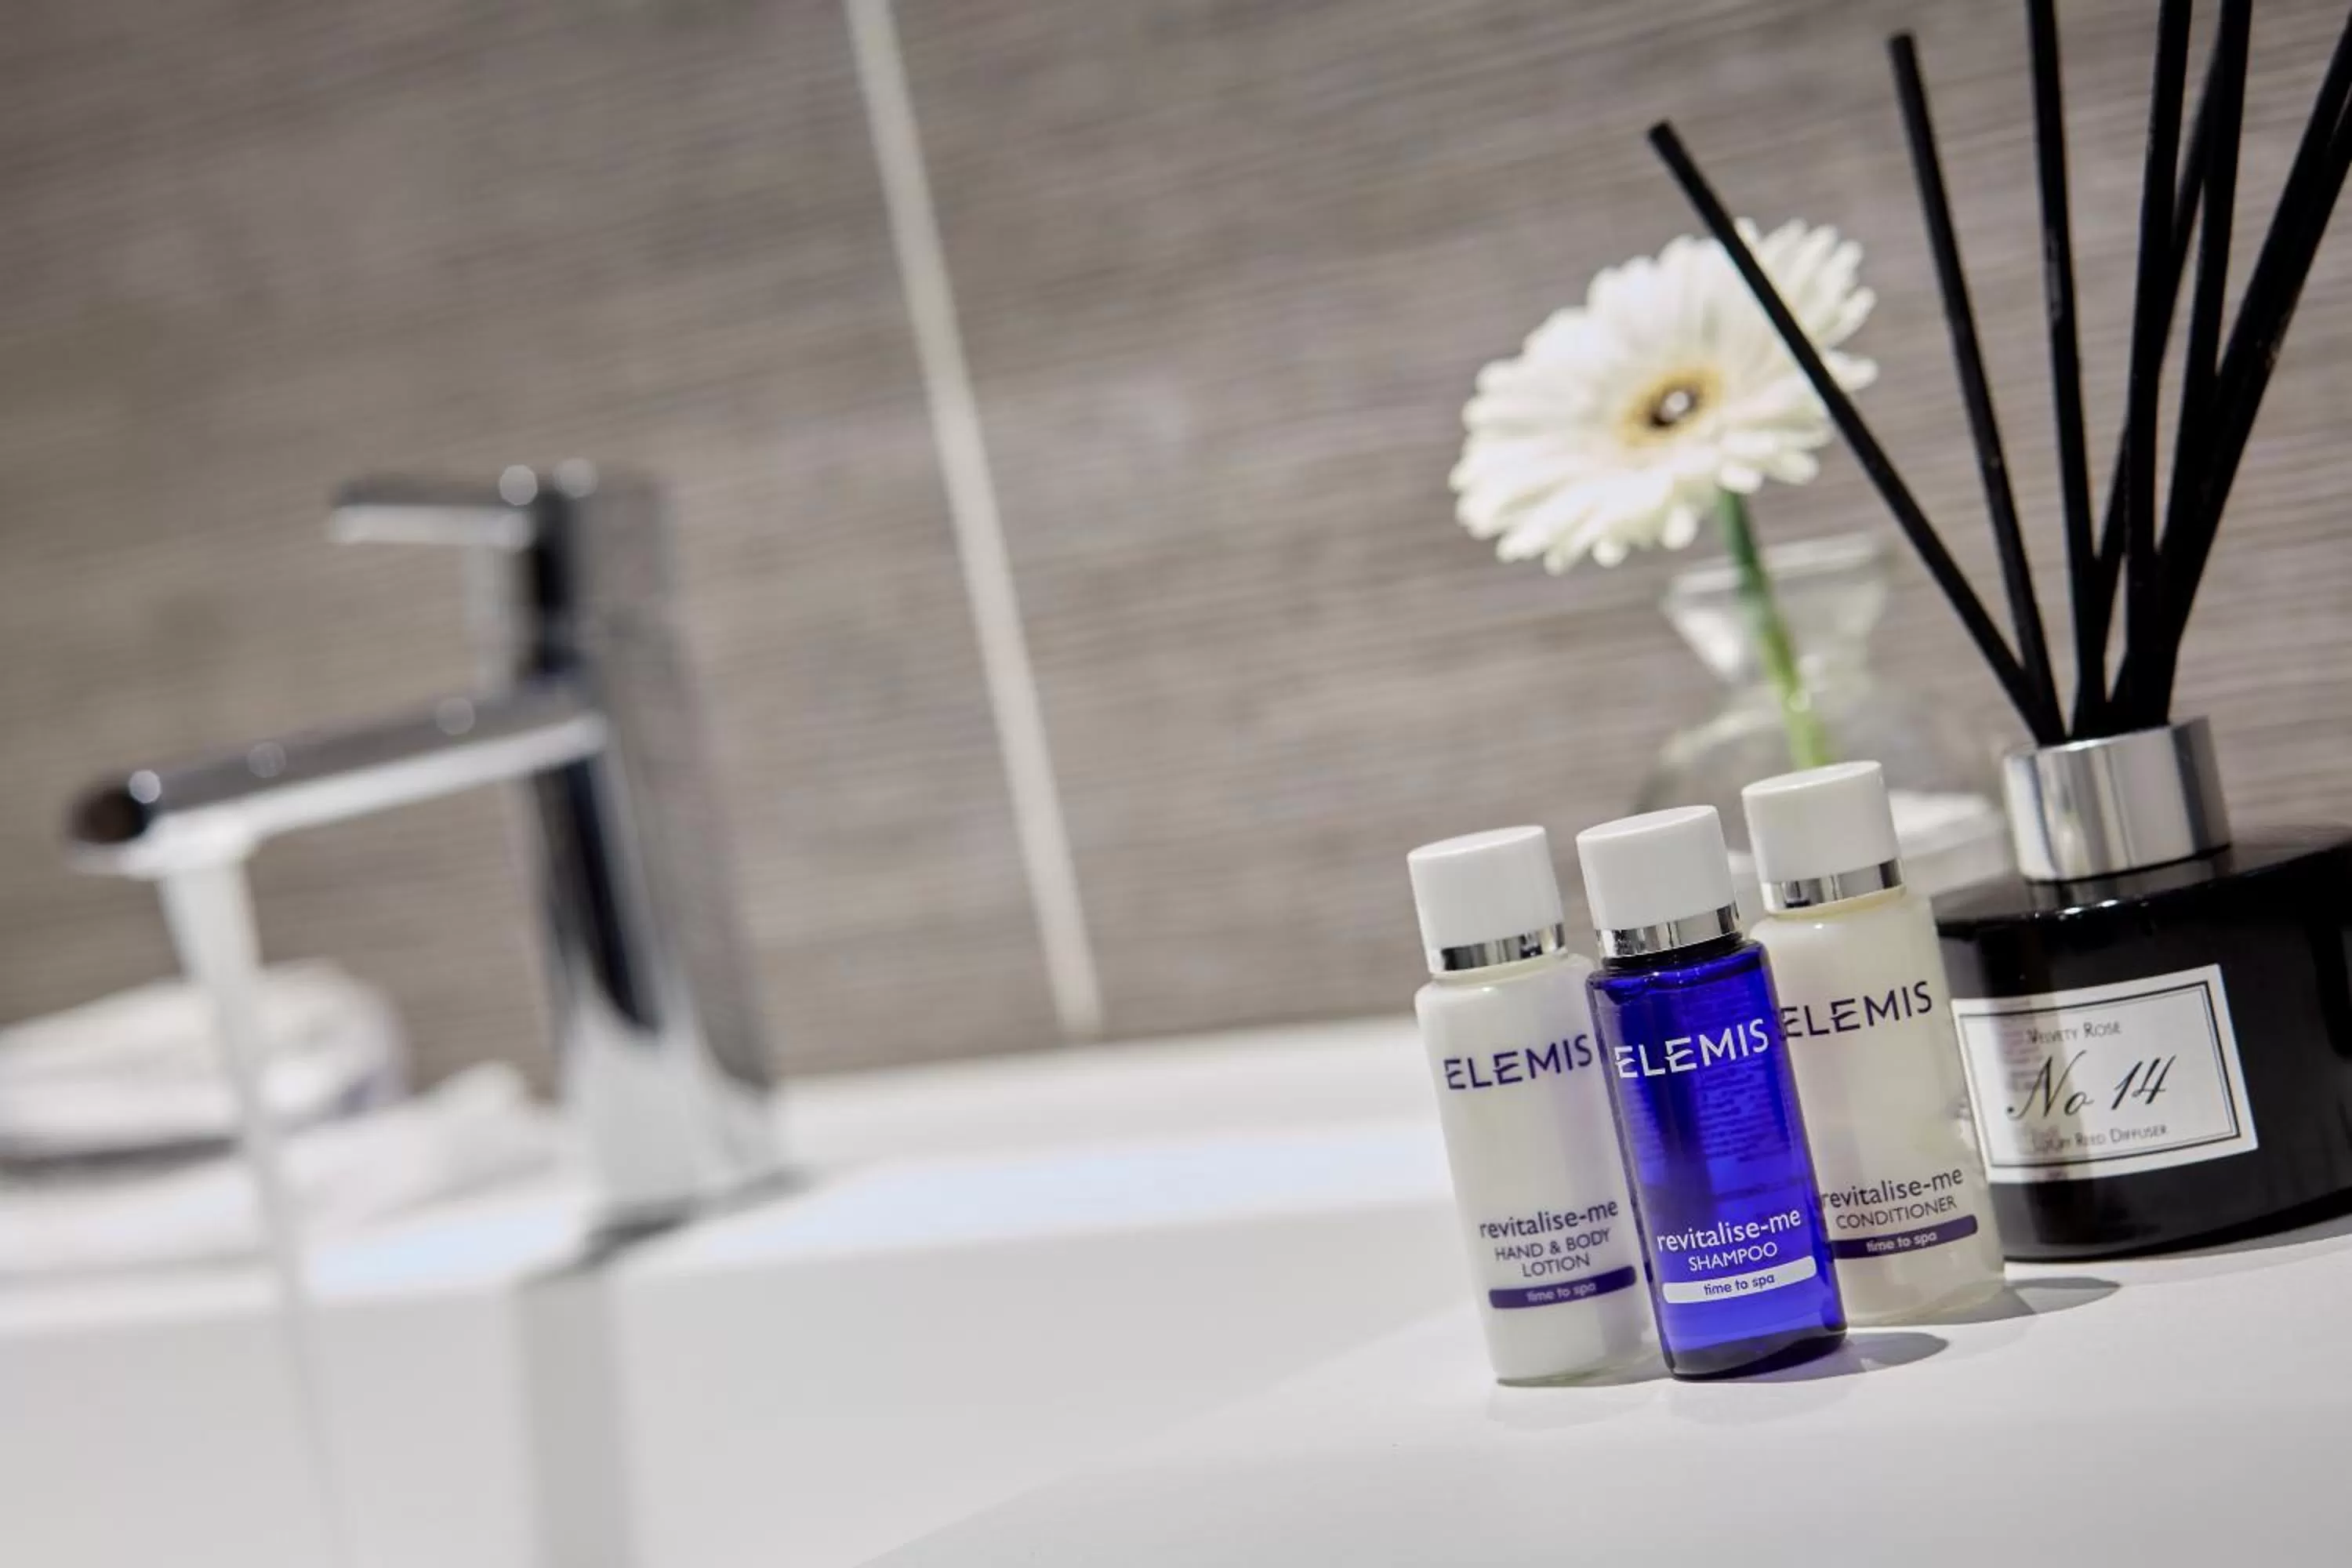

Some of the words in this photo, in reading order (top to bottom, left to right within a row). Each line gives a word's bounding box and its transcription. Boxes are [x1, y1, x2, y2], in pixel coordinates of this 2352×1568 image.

[1780, 980, 1933, 1038] ELEMIS
[1443, 1033, 1594, 1091] ELEMIS
[1613, 1018, 1769, 1080] ELEMIS
[2005, 1049, 2095, 1120] No
[2111, 1054, 2177, 1111] 14
[1821, 1168, 1964, 1209] revitalise-me
[1479, 1200, 1619, 1240] revitalise-me
[1657, 1209, 1802, 1253] revitalise-me
[1835, 1195, 1958, 1230] CONDITIONER
[1494, 1242, 1544, 1261] HAND
[1549, 1240, 1562, 1254] &
[1565, 1228, 1612, 1251] BODY
[1688, 1241, 1778, 1272] SHAMPOO
[1866, 1240, 1895, 1253] time
[1896, 1237, 1911, 1249] to
[1915, 1231, 1937, 1246] spa
[1522, 1254, 1592, 1278] LOTION
[1704, 1283, 1733, 1296] time
[1734, 1278, 1748, 1290] to
[1752, 1273, 1775, 1289] spa
[1556, 1287, 1571, 1299] to
